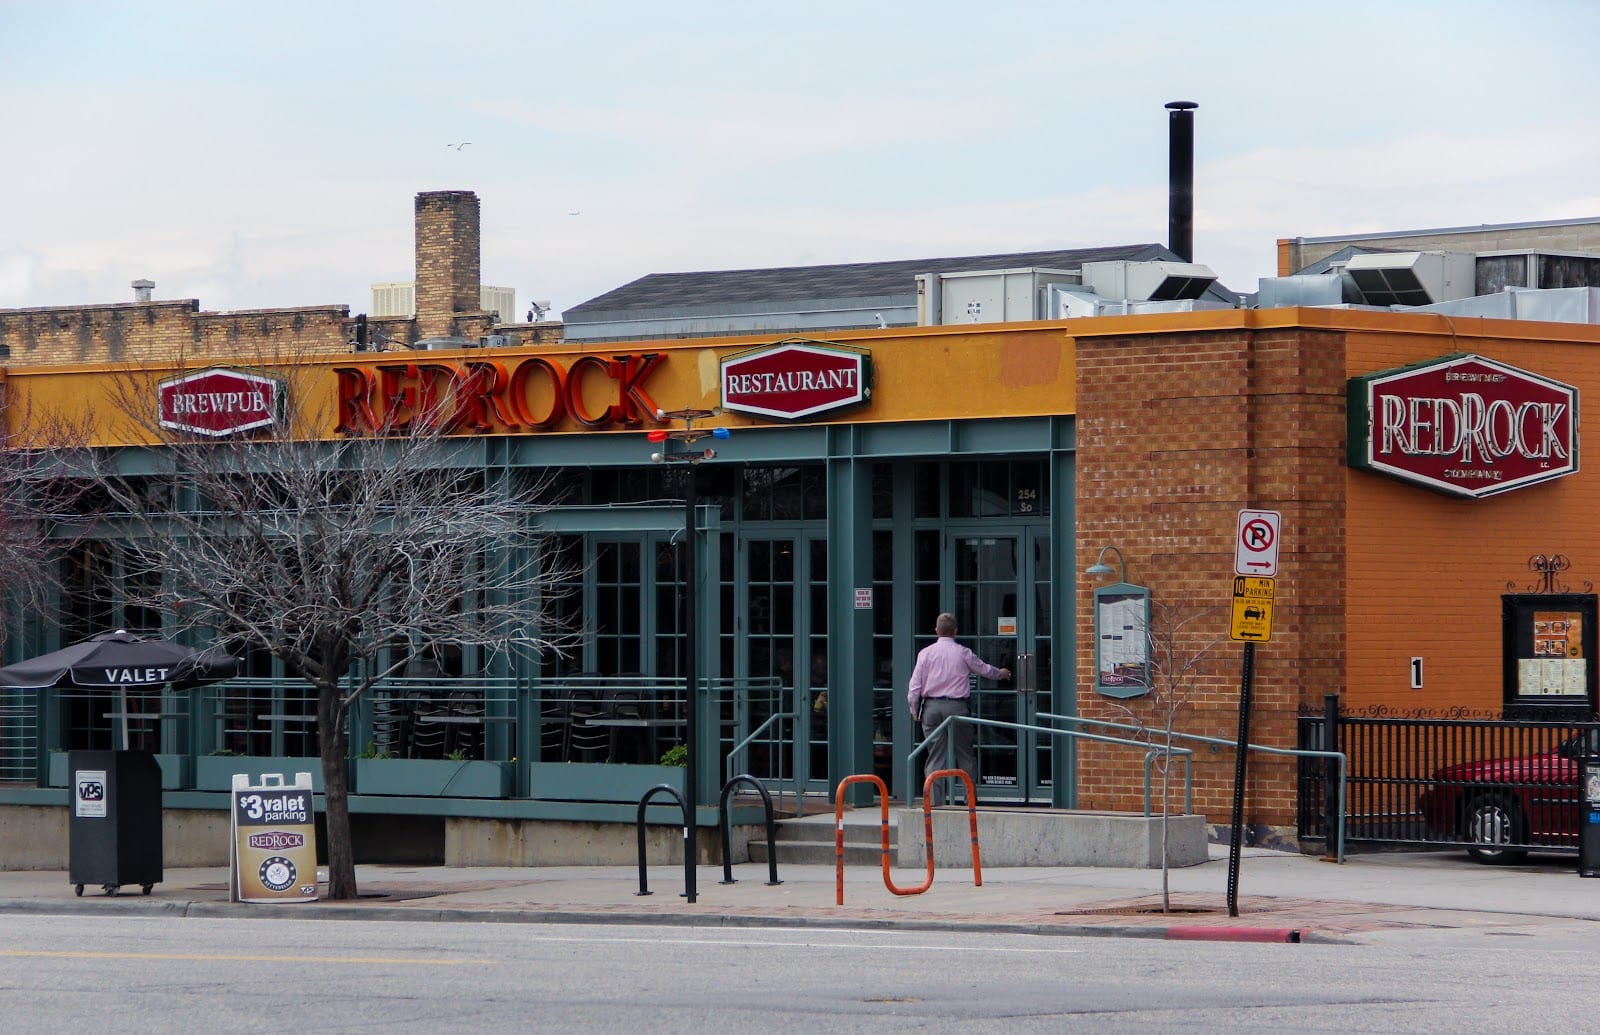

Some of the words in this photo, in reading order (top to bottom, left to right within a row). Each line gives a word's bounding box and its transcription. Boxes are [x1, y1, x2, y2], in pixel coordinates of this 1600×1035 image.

[728, 368, 857, 395] RESTAURANT
[172, 391, 265, 414] BREWPUB
[1379, 392, 1569, 464] REDROCK
[1444, 469, 1503, 480] COMPANY
[1018, 489, 1036, 500] 254
[1021, 502, 1033, 512] So
[1234, 578, 1245, 595] 10
[1259, 579, 1270, 588] MIN
[1245, 587, 1273, 597] PARKING
[105, 668, 169, 683] VALET
[1412, 659, 1422, 686] 1
[263, 795, 305, 811] valet
[265, 810, 306, 823] parking
[251, 835, 302, 847] REDROCK
